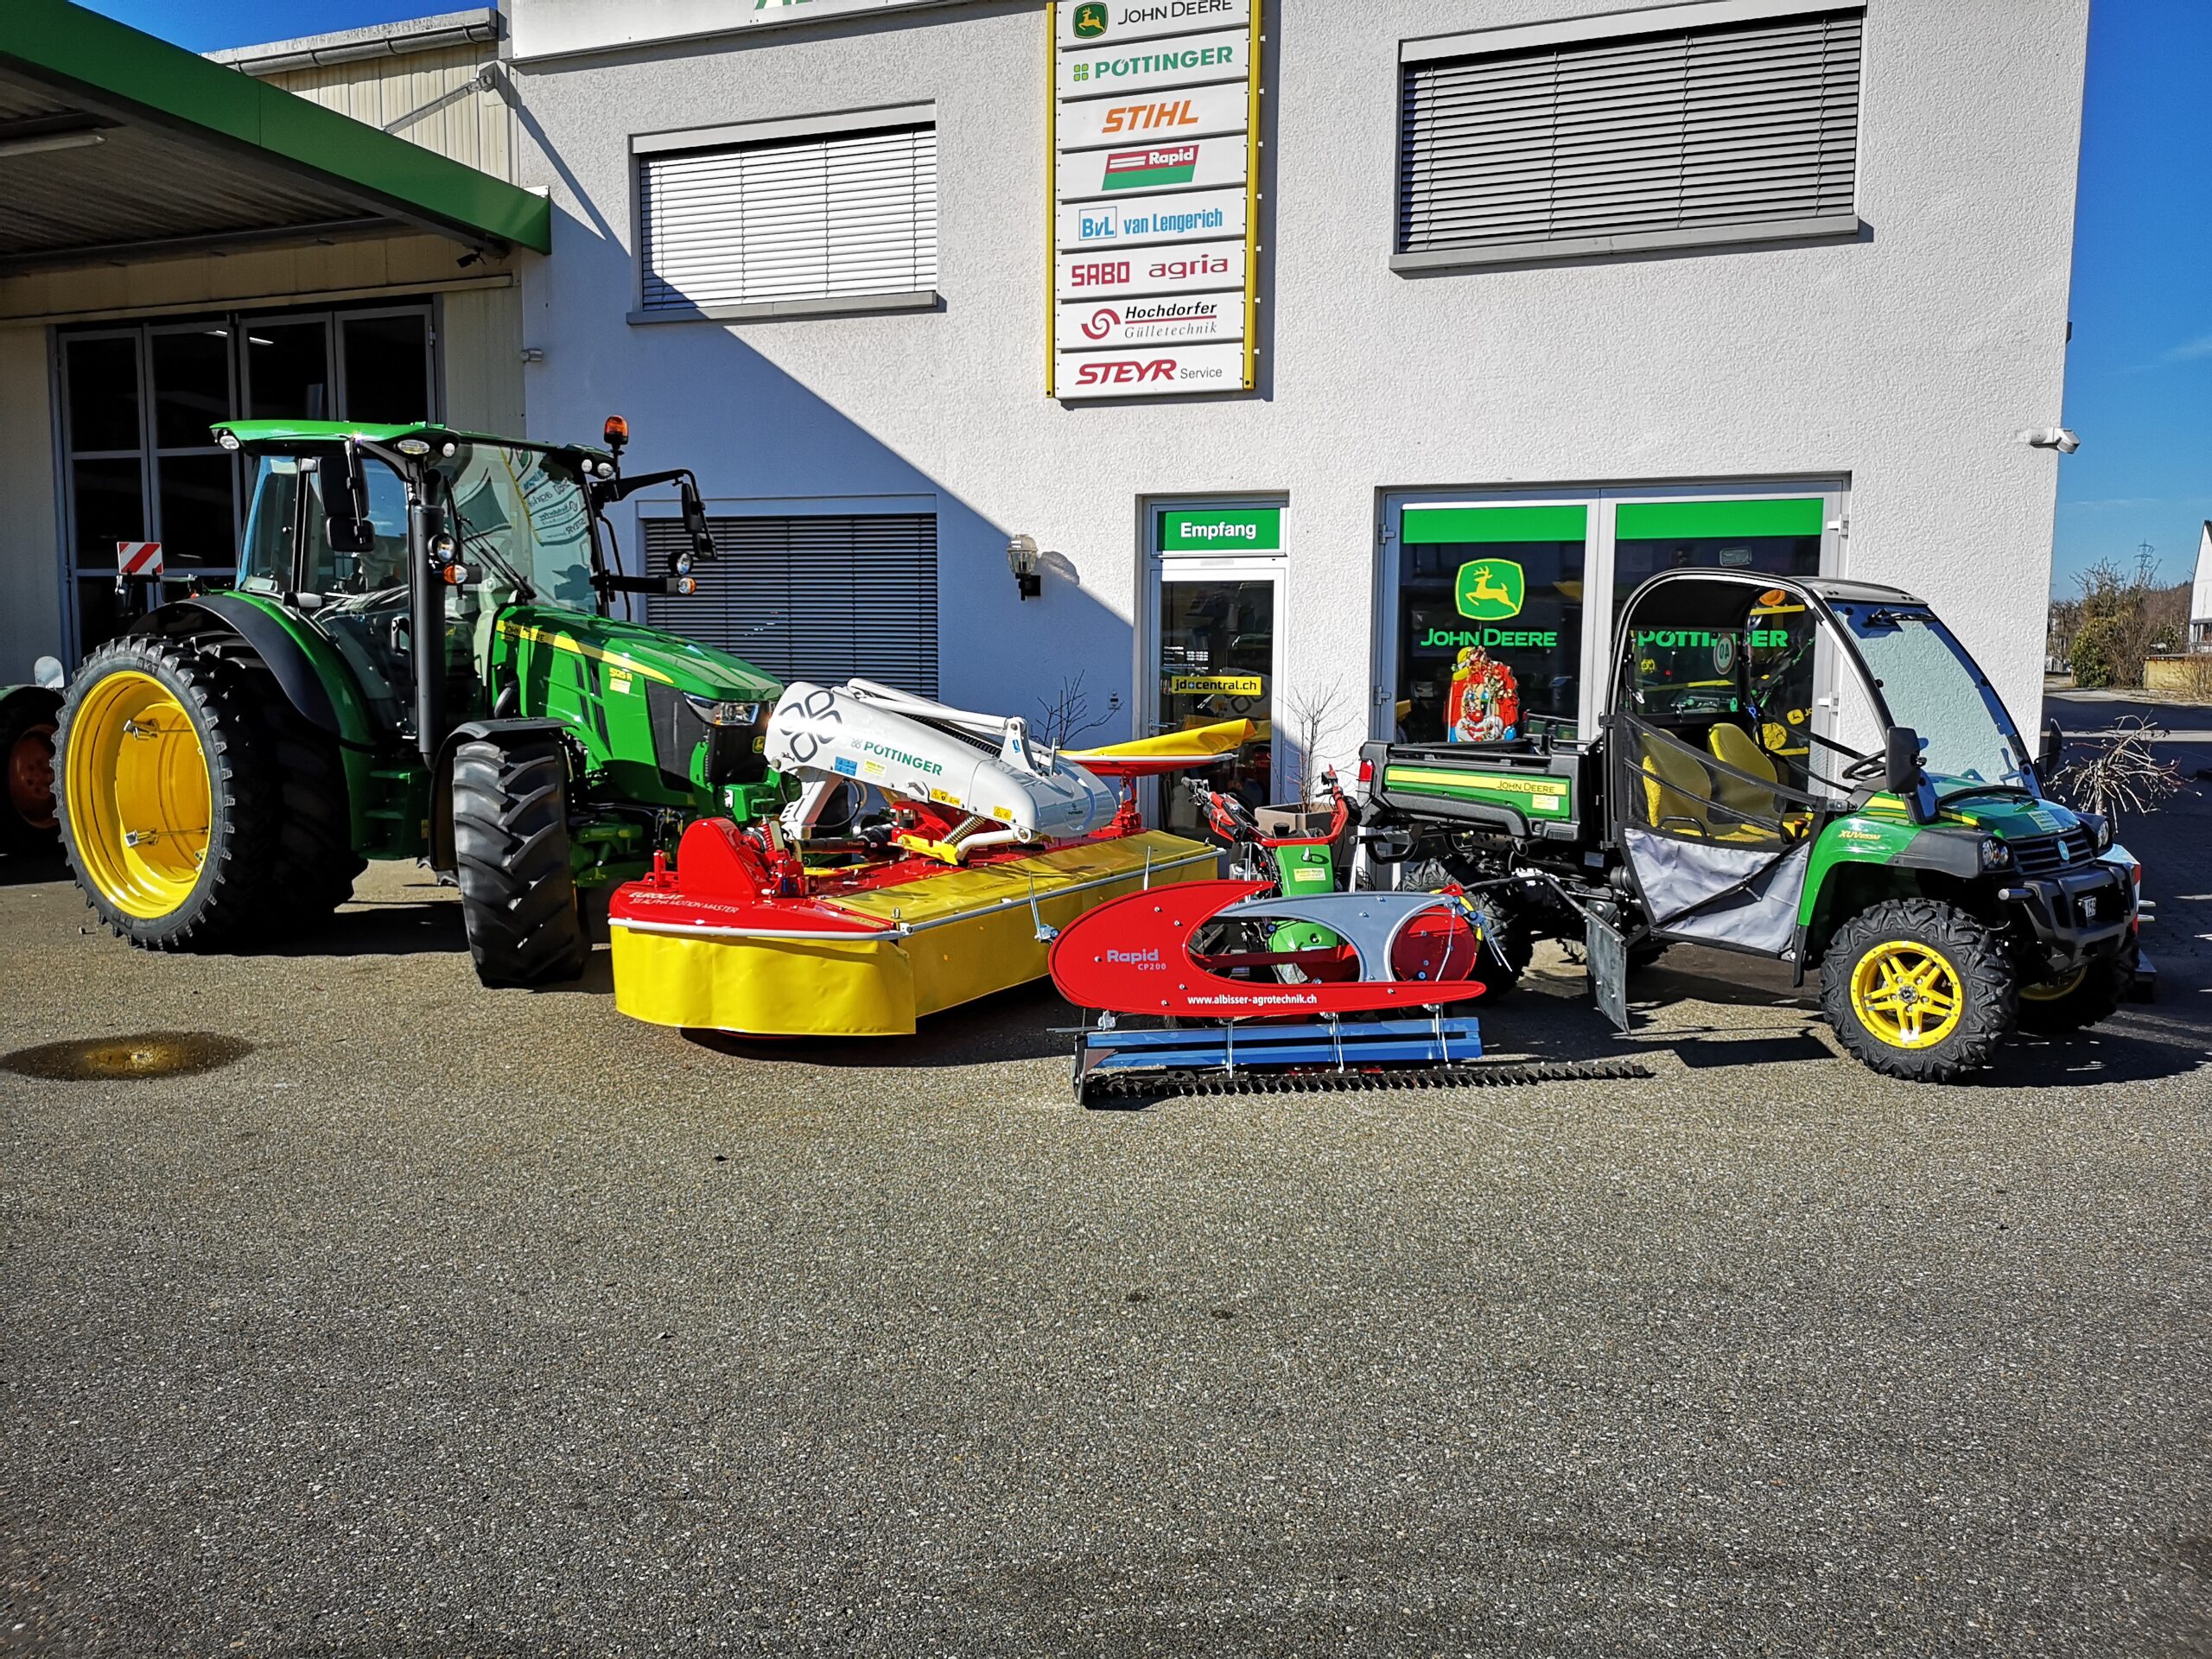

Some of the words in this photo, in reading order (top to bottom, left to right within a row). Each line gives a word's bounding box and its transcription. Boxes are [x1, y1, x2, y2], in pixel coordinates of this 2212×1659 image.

[1118, 6, 1167, 25] JOHN
[1171, 0, 1233, 18] DEERE
[1095, 46, 1233, 79] PÖTTINGER
[1102, 100, 1199, 133] STIHL
[1148, 147, 1194, 166] Rapid
[1082, 216, 1115, 238] BvL
[1124, 217, 1148, 235] van
[1153, 207, 1223, 233] Lengerich
[1071, 262, 1130, 287] SABO
[1149, 254, 1228, 279] agria
[1125, 302, 1217, 319] Hochdorfer
[1124, 322, 1217, 339] Gülletechnik
[1075, 359, 1177, 385] STEYR
[1180, 367, 1223, 379] Service
[1180, 521, 1256, 540] Empfang
[1421, 628, 1480, 646] JOHN
[1484, 628, 1558, 646] DEERE
[1497, 780, 1522, 791] JOHN
[1524, 782, 1555, 793] DEERE
[1107, 949, 1158, 963] Rapid
[1187, 994, 1318, 1007] www.albisser-agrotechnik.ch
